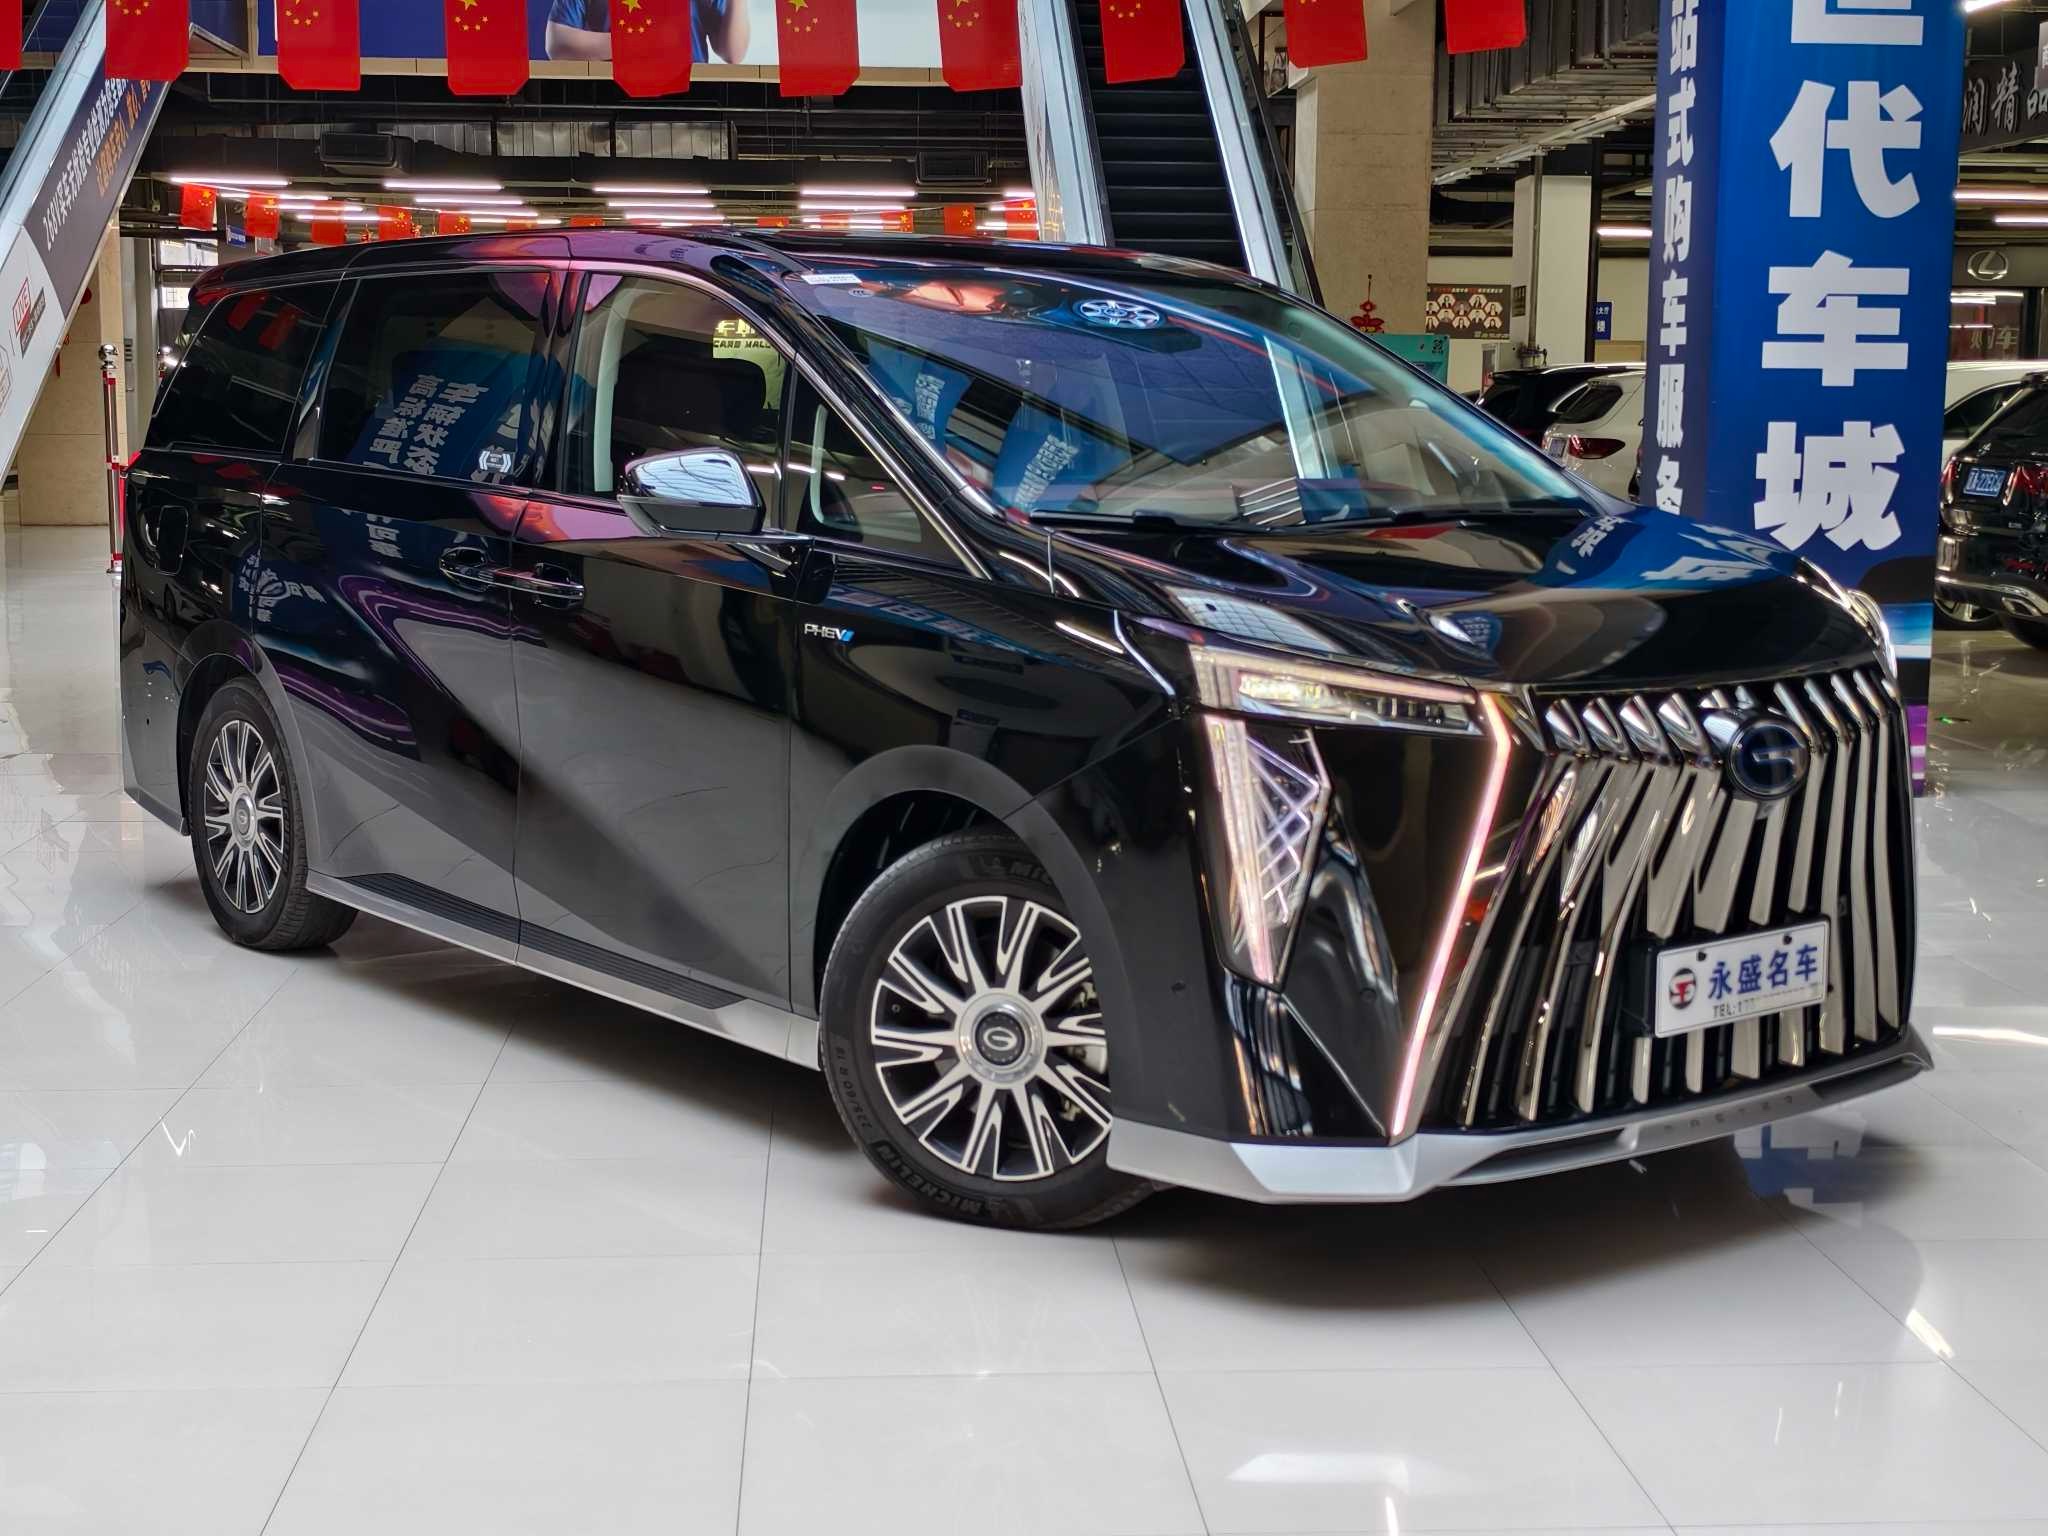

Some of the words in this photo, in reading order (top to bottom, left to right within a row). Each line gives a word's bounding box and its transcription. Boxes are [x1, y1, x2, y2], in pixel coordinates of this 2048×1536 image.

[804, 623, 850, 641] PHEV
[1708, 944, 1818, 1000] 永盛名车
[876, 1143, 981, 1215] MICHELIN
